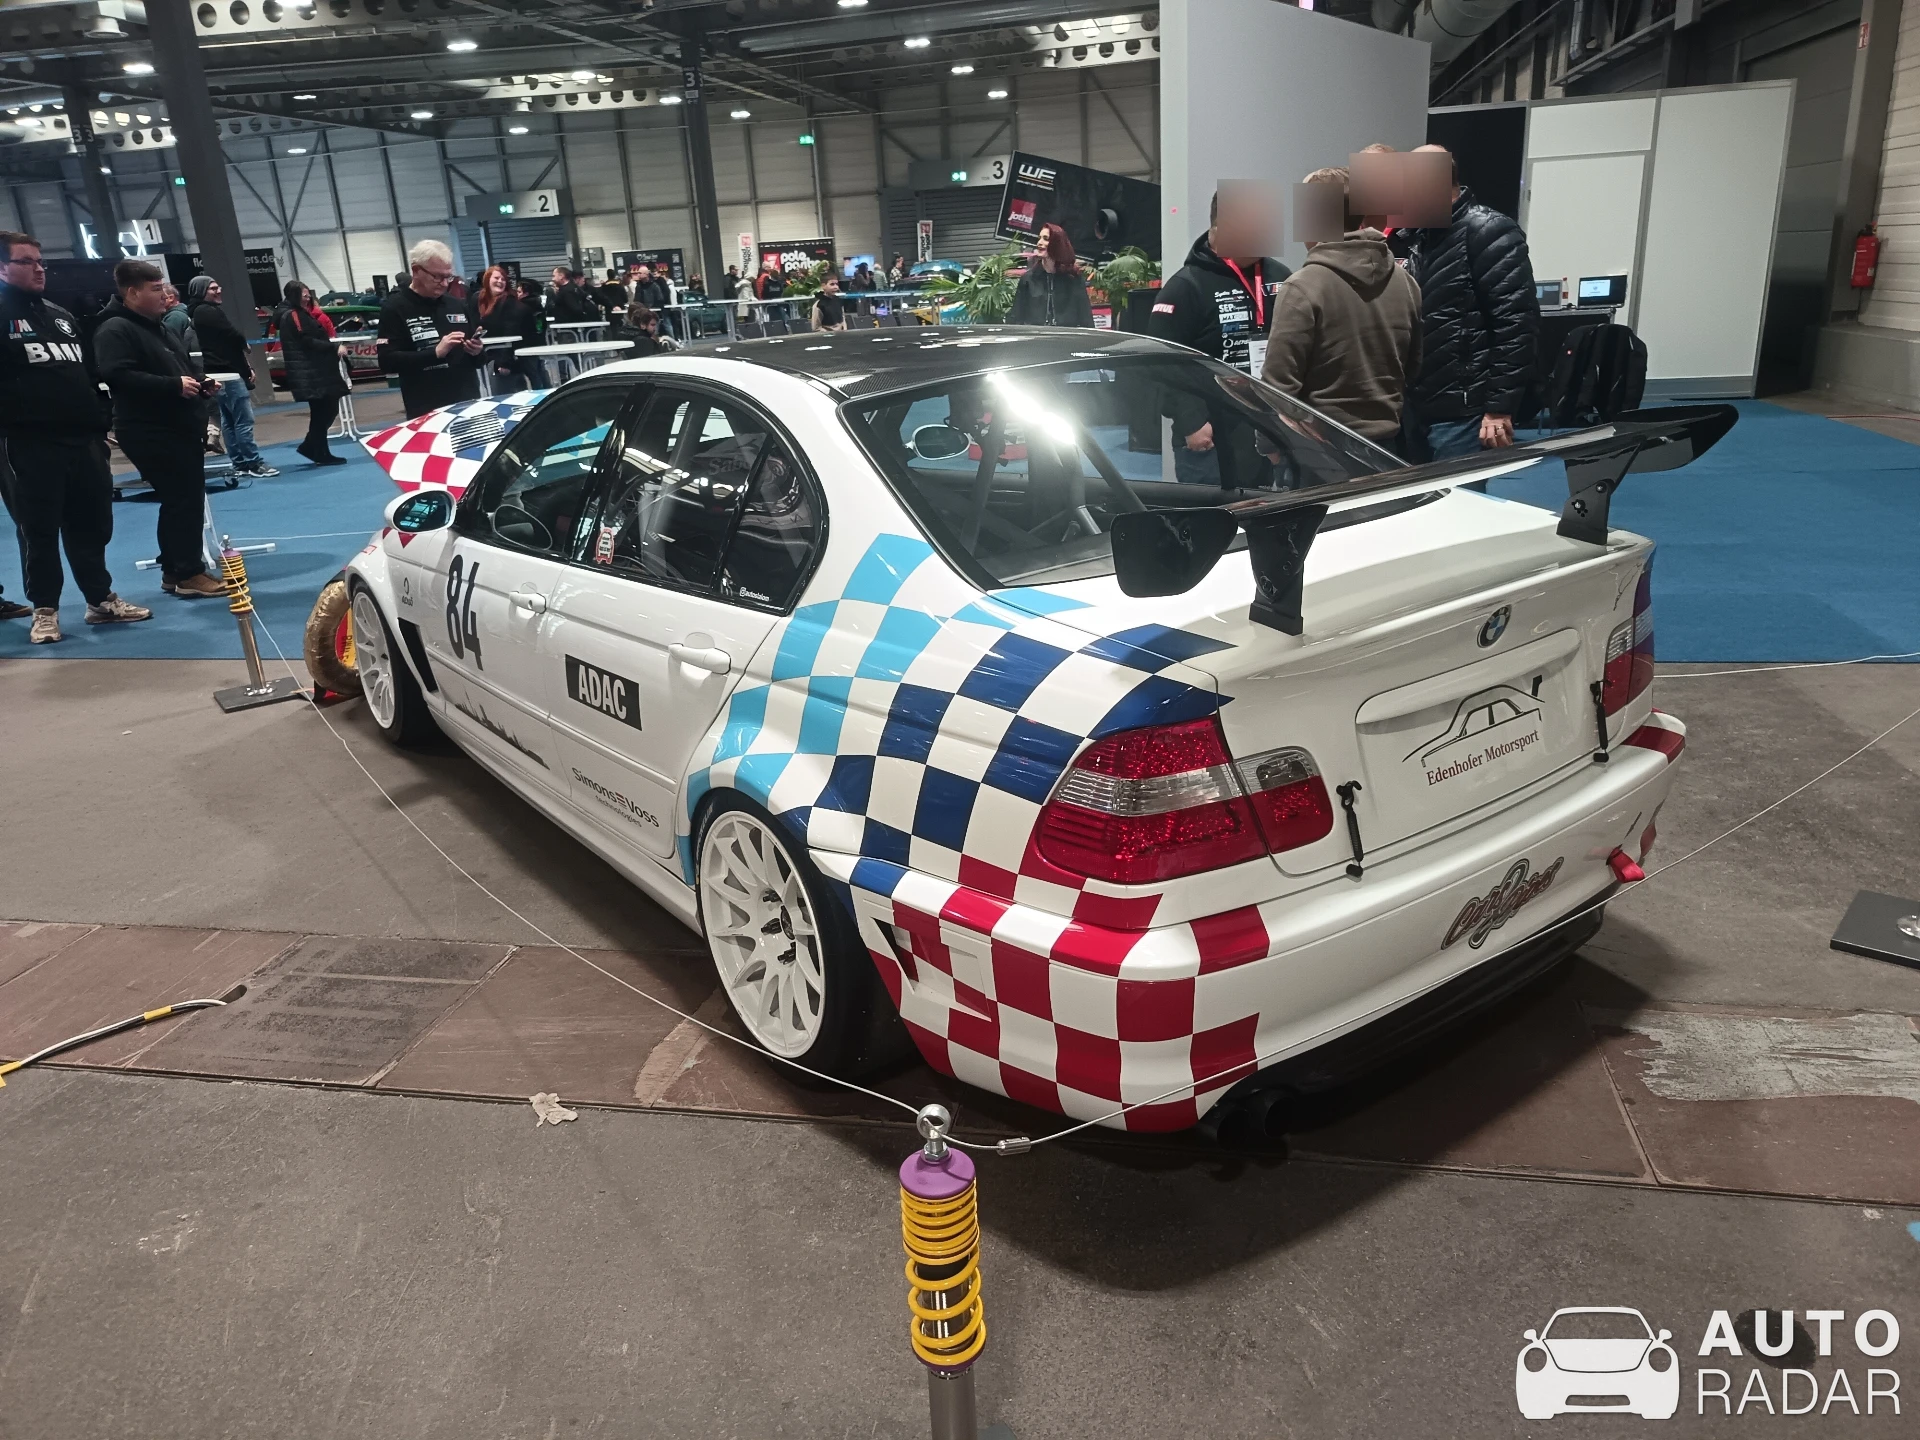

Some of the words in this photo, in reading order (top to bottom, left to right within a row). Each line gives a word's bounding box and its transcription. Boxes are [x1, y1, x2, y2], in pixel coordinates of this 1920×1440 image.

[685, 72, 696, 87] 3
[73, 129, 82, 143] 3
[993, 161, 1004, 180] 3
[538, 194, 550, 212] 2
[145, 223, 154, 240] 1
[780, 250, 807, 265] pole
[446, 554, 484, 672] 84
[578, 663, 627, 720] ADAC
[1426, 754, 1483, 786] Edenhofer
[1484, 729, 1540, 763] Motorsport
